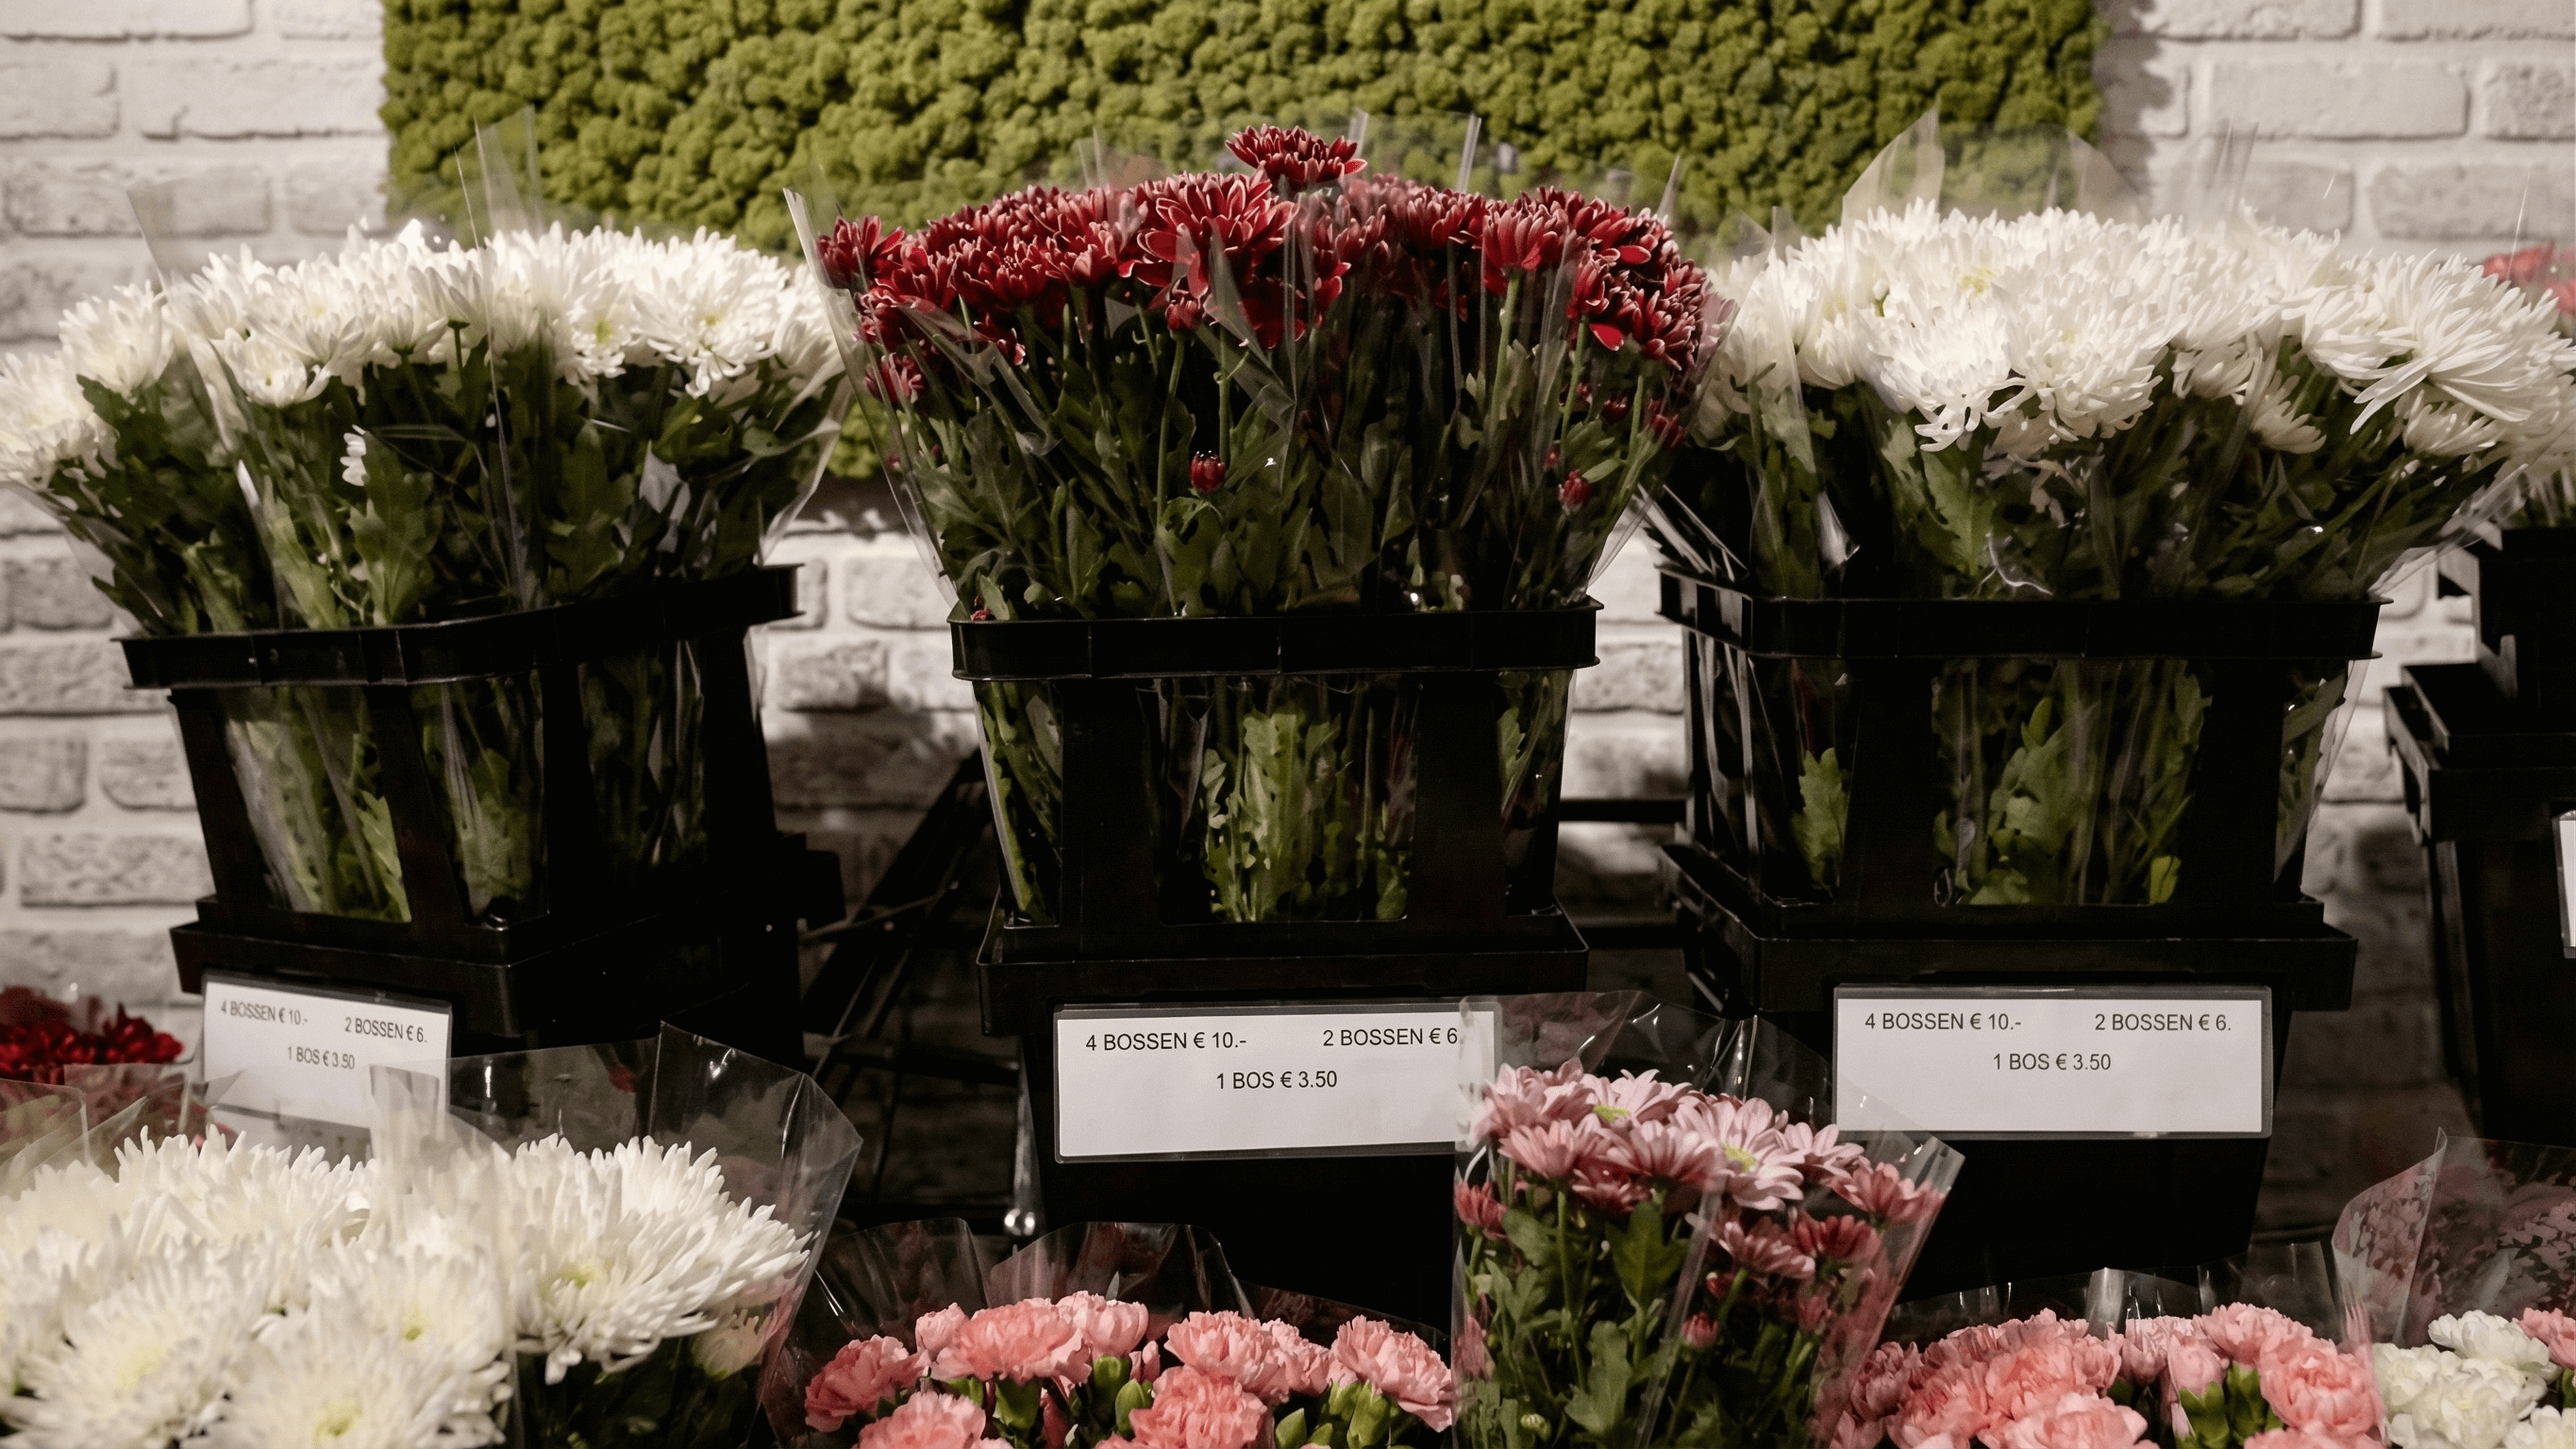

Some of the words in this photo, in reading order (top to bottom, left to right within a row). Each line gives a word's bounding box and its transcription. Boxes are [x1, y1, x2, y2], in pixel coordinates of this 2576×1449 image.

[220, 1000, 227, 1014] 4
[229, 1000, 276, 1022] BOSSEN
[277, 1007, 286, 1024] €
[1865, 1012, 1876, 1030] 4
[1882, 1012, 1965, 1031] BOSSEN
[1969, 1012, 1982, 1031] €
[1987, 1012, 2022, 1031] 10.-
[2095, 1013, 2106, 1031] 2
[2112, 1013, 2193, 1032] BOSSEN
[2198, 1013, 2211, 1032] €
[2215, 1013, 2232, 1032] 6.
[344, 1016, 352, 1033] 2
[355, 1017, 404, 1040] BOSSEN
[405, 1024, 414, 1041] €
[416, 1026, 428, 1043] 6.
[1322, 1029, 1334, 1047] 2
[1340, 1027, 1424, 1047] BOSSEN
[1428, 1026, 1442, 1045] €
[1085, 1034, 1097, 1052] 4
[1103, 1032, 1187, 1052] BOSSEN
[1193, 1031, 1206, 1049] €
[1212, 1031, 1247, 1049] 10.-
[287, 1045, 293, 1061] 1
[295, 1045, 321, 1065] BOS
[322, 1049, 330, 1067] €
[1992, 1053, 2000, 1071] 1
[2009, 1052, 2050, 1071] BOS
[2055, 1052, 2068, 1071] €
[2072, 1053, 2112, 1071] 3.50
[1215, 1072, 1225, 1091] 1
[1232, 1071, 1275, 1090] BOS
[1280, 1070, 1293, 1089] €
[1297, 1070, 1338, 1089] 3.50
